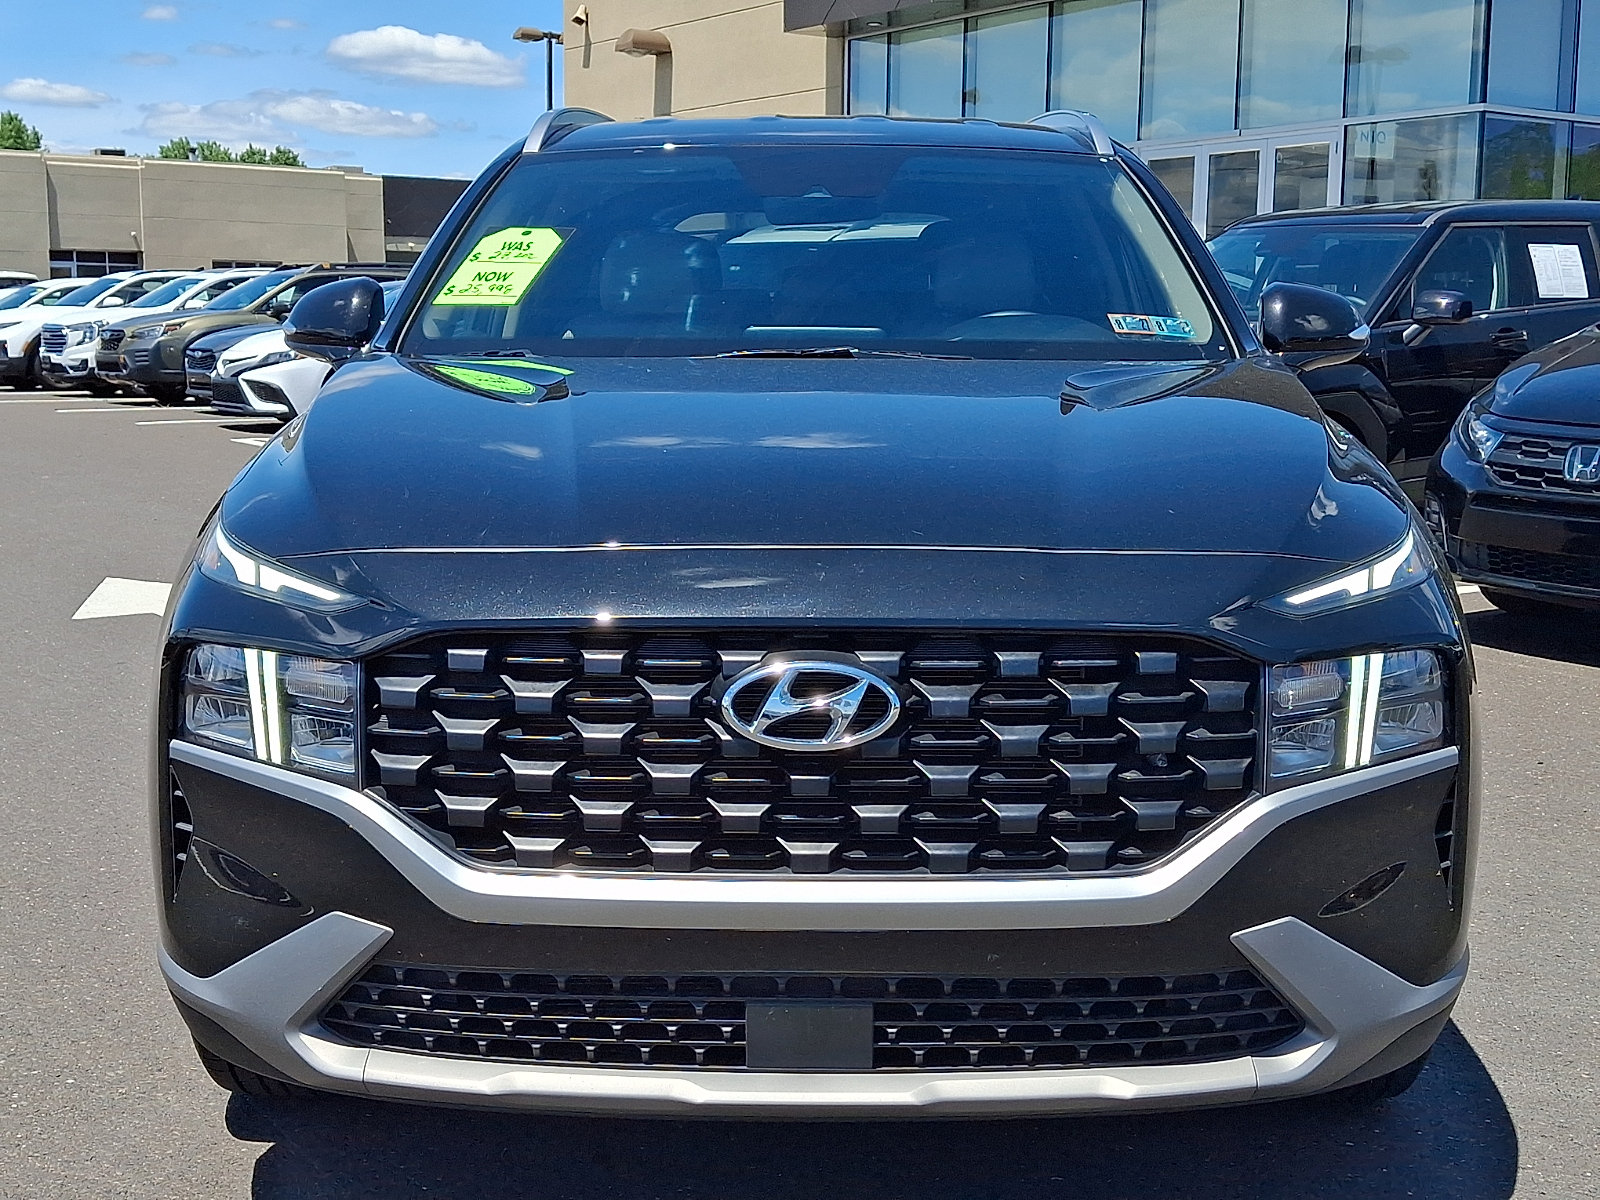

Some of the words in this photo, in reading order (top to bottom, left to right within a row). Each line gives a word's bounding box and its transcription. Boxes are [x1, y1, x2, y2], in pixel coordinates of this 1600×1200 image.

[501, 241, 533, 251] WAS
[469, 252, 482, 262] $
[472, 271, 515, 282] NOW
[443, 285, 456, 296] $
